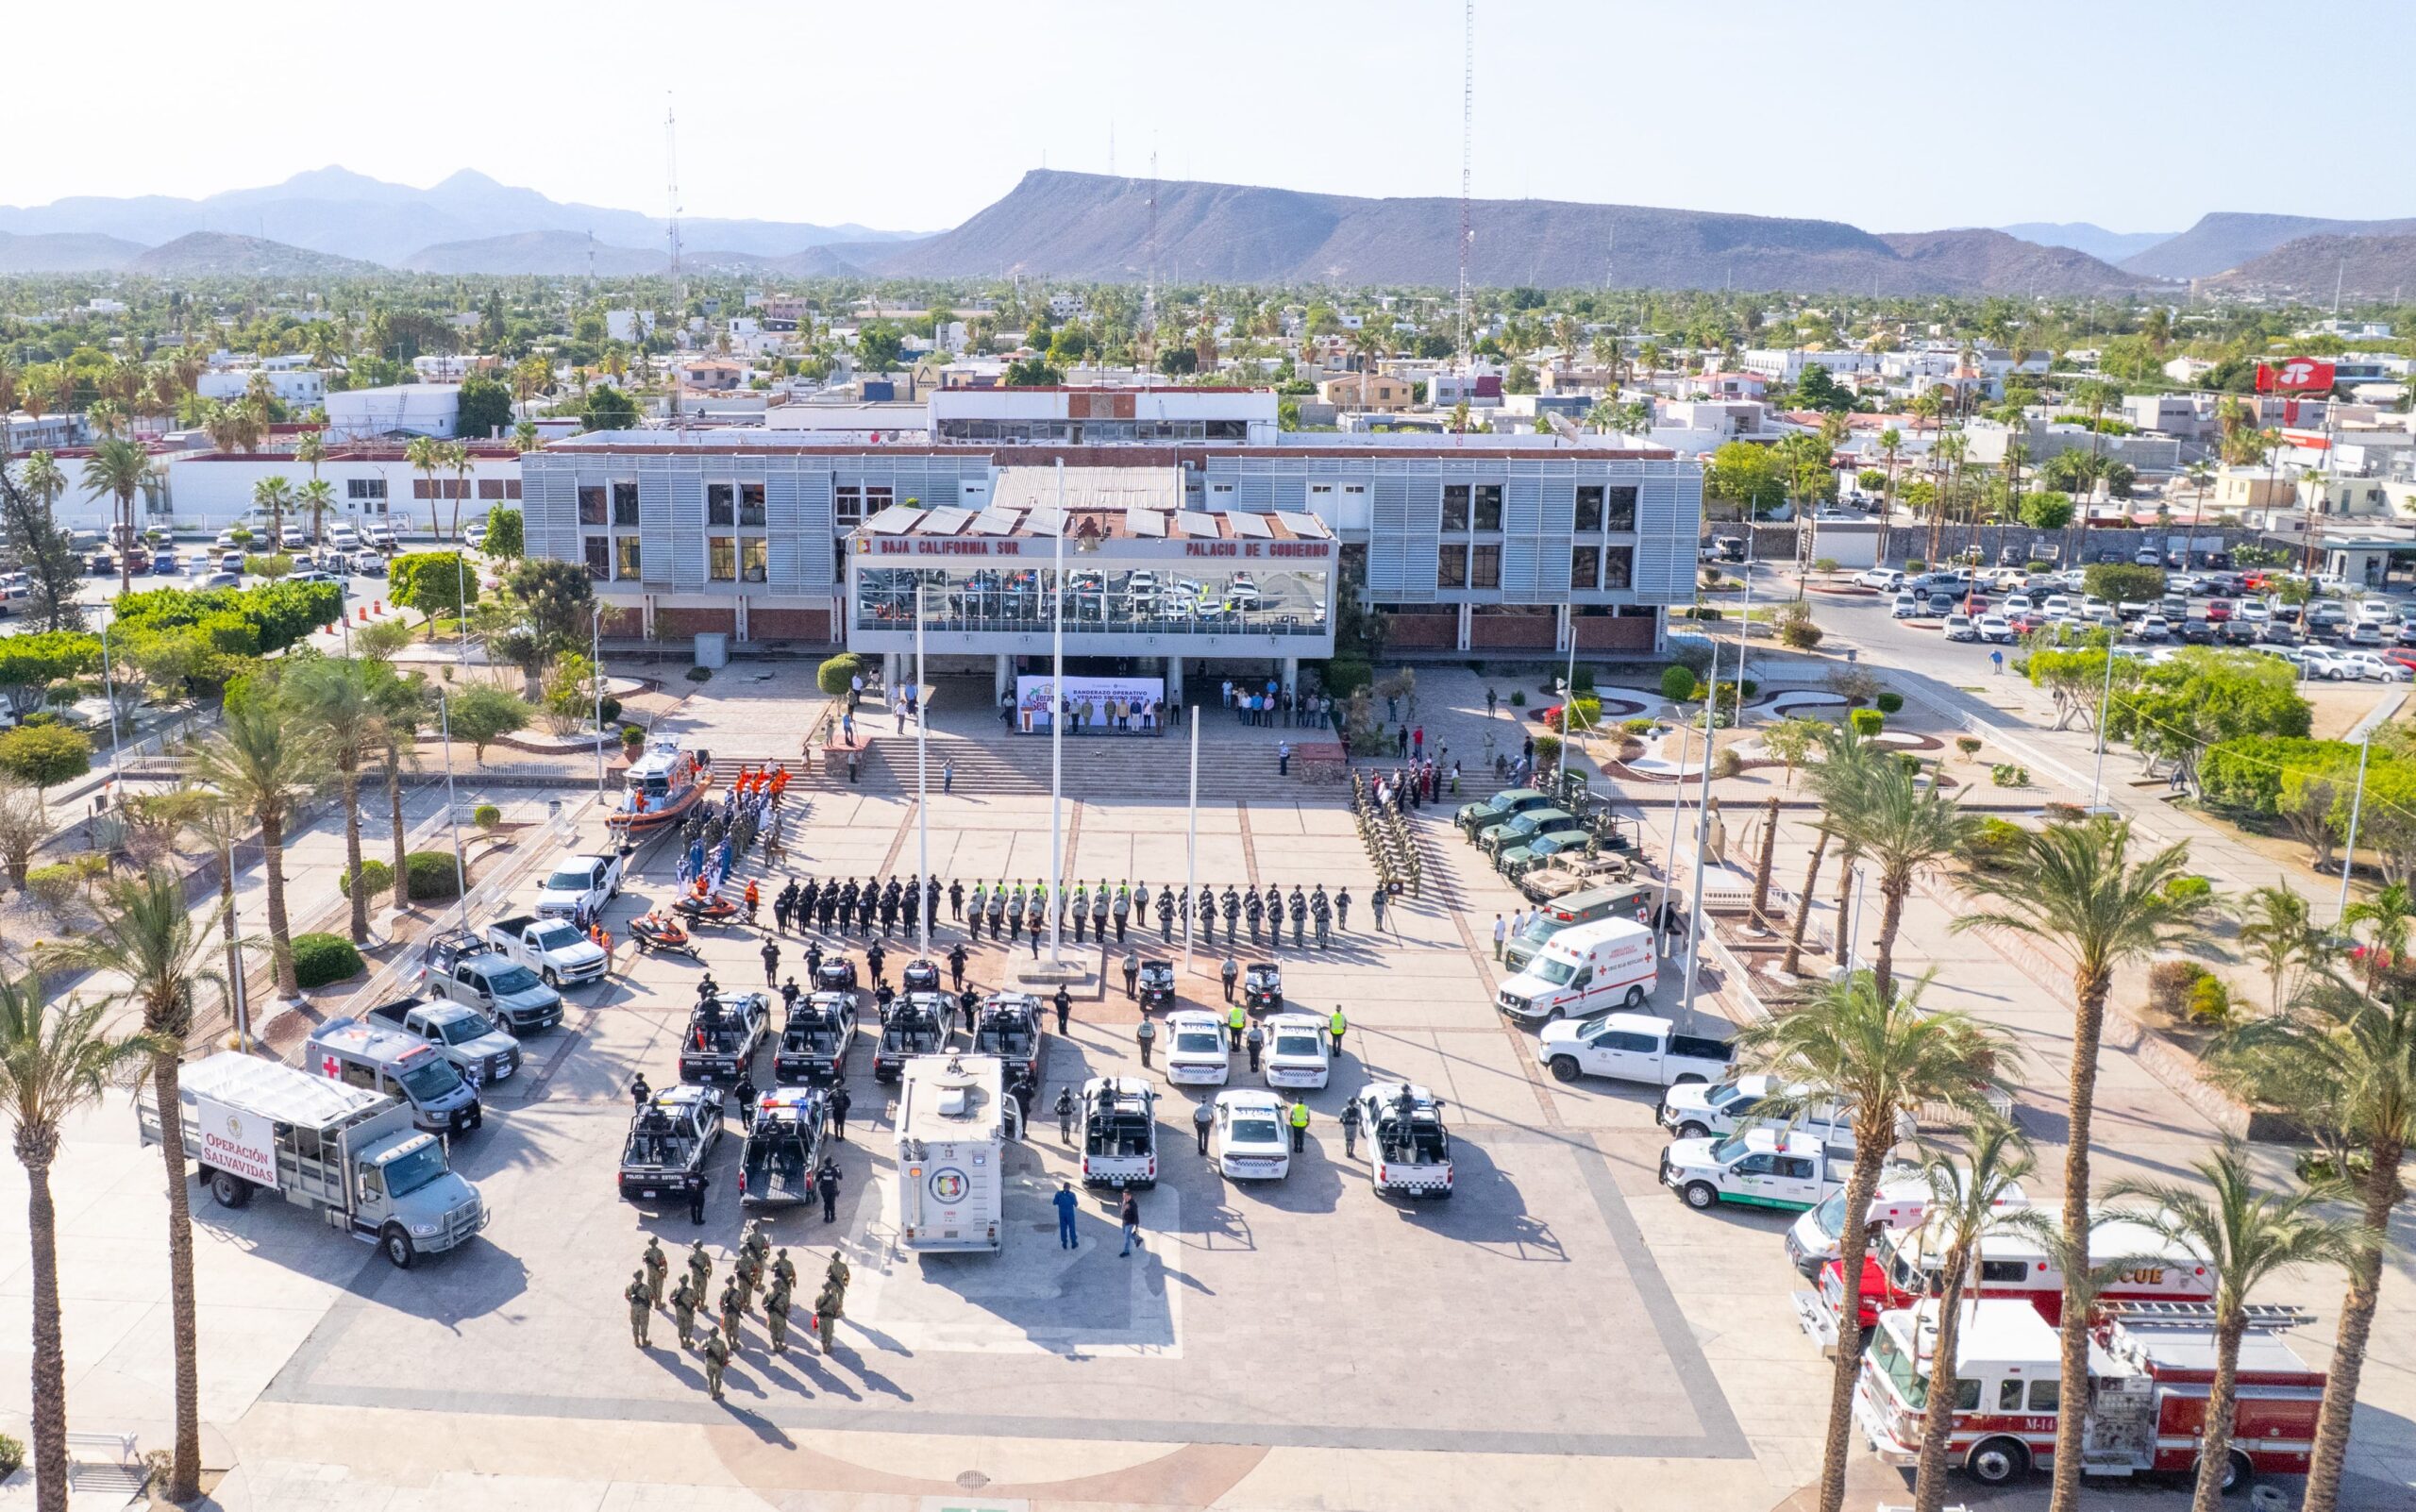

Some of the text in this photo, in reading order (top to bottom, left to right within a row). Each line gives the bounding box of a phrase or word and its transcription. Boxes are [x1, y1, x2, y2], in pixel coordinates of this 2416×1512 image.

[881, 541, 1019, 555] BAJA CALIFORNIA SUR
[1186, 543, 1330, 557] PALACIO DE GOBIERNO
[206, 1133, 268, 1165] OPERACIÓN
[204, 1147, 274, 1183] SALVAVIDAS
